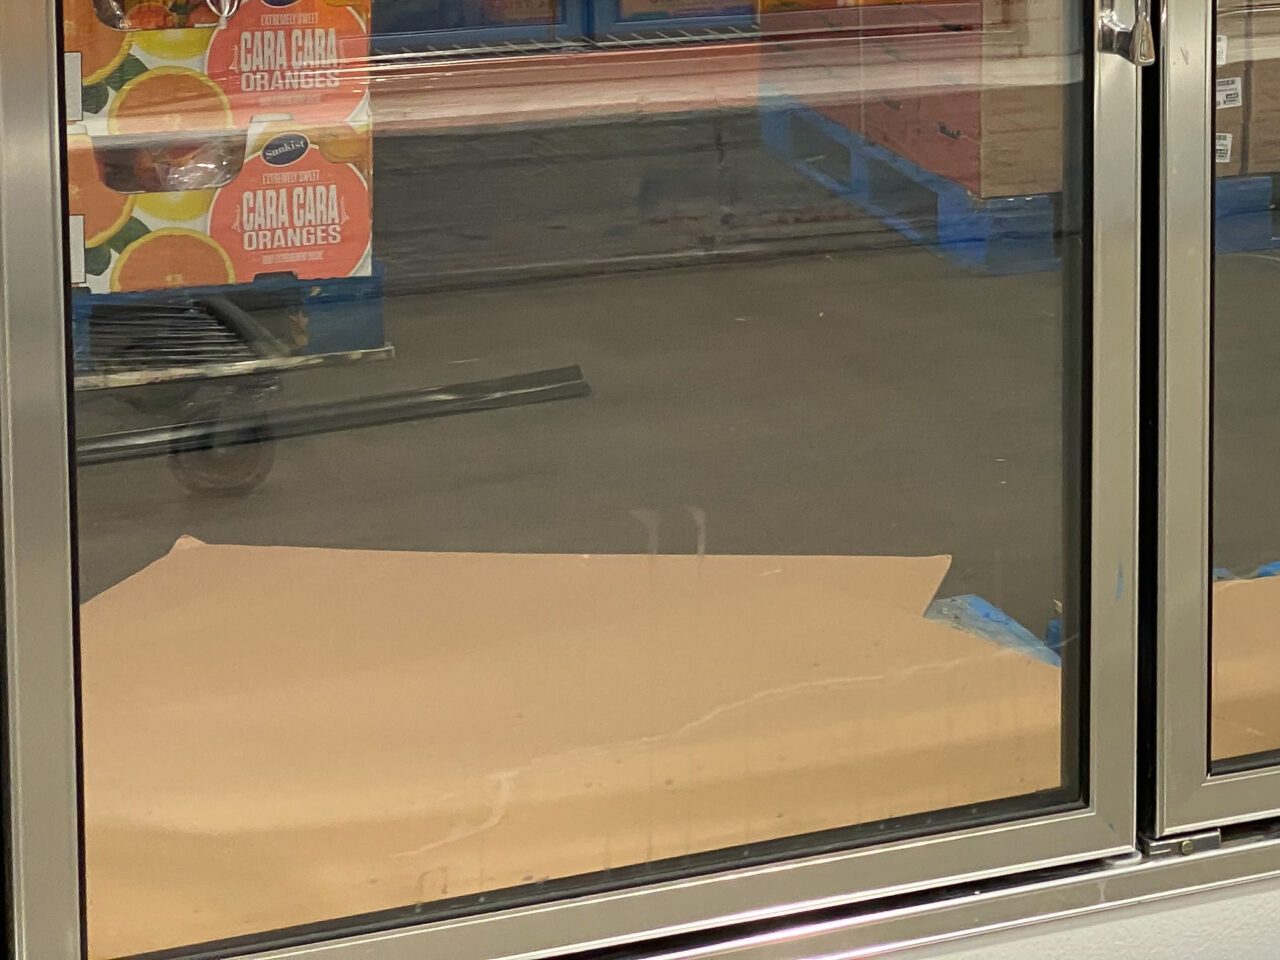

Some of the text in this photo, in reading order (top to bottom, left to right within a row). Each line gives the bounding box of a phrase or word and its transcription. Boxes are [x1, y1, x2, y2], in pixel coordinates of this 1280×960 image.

[240, 28, 337, 72] CARA CARA
[240, 69, 340, 91] ORANGES
[265, 139, 307, 158] Sunkist
[242, 185, 339, 231] CARA CARA
[243, 226, 341, 250] ORANGES
